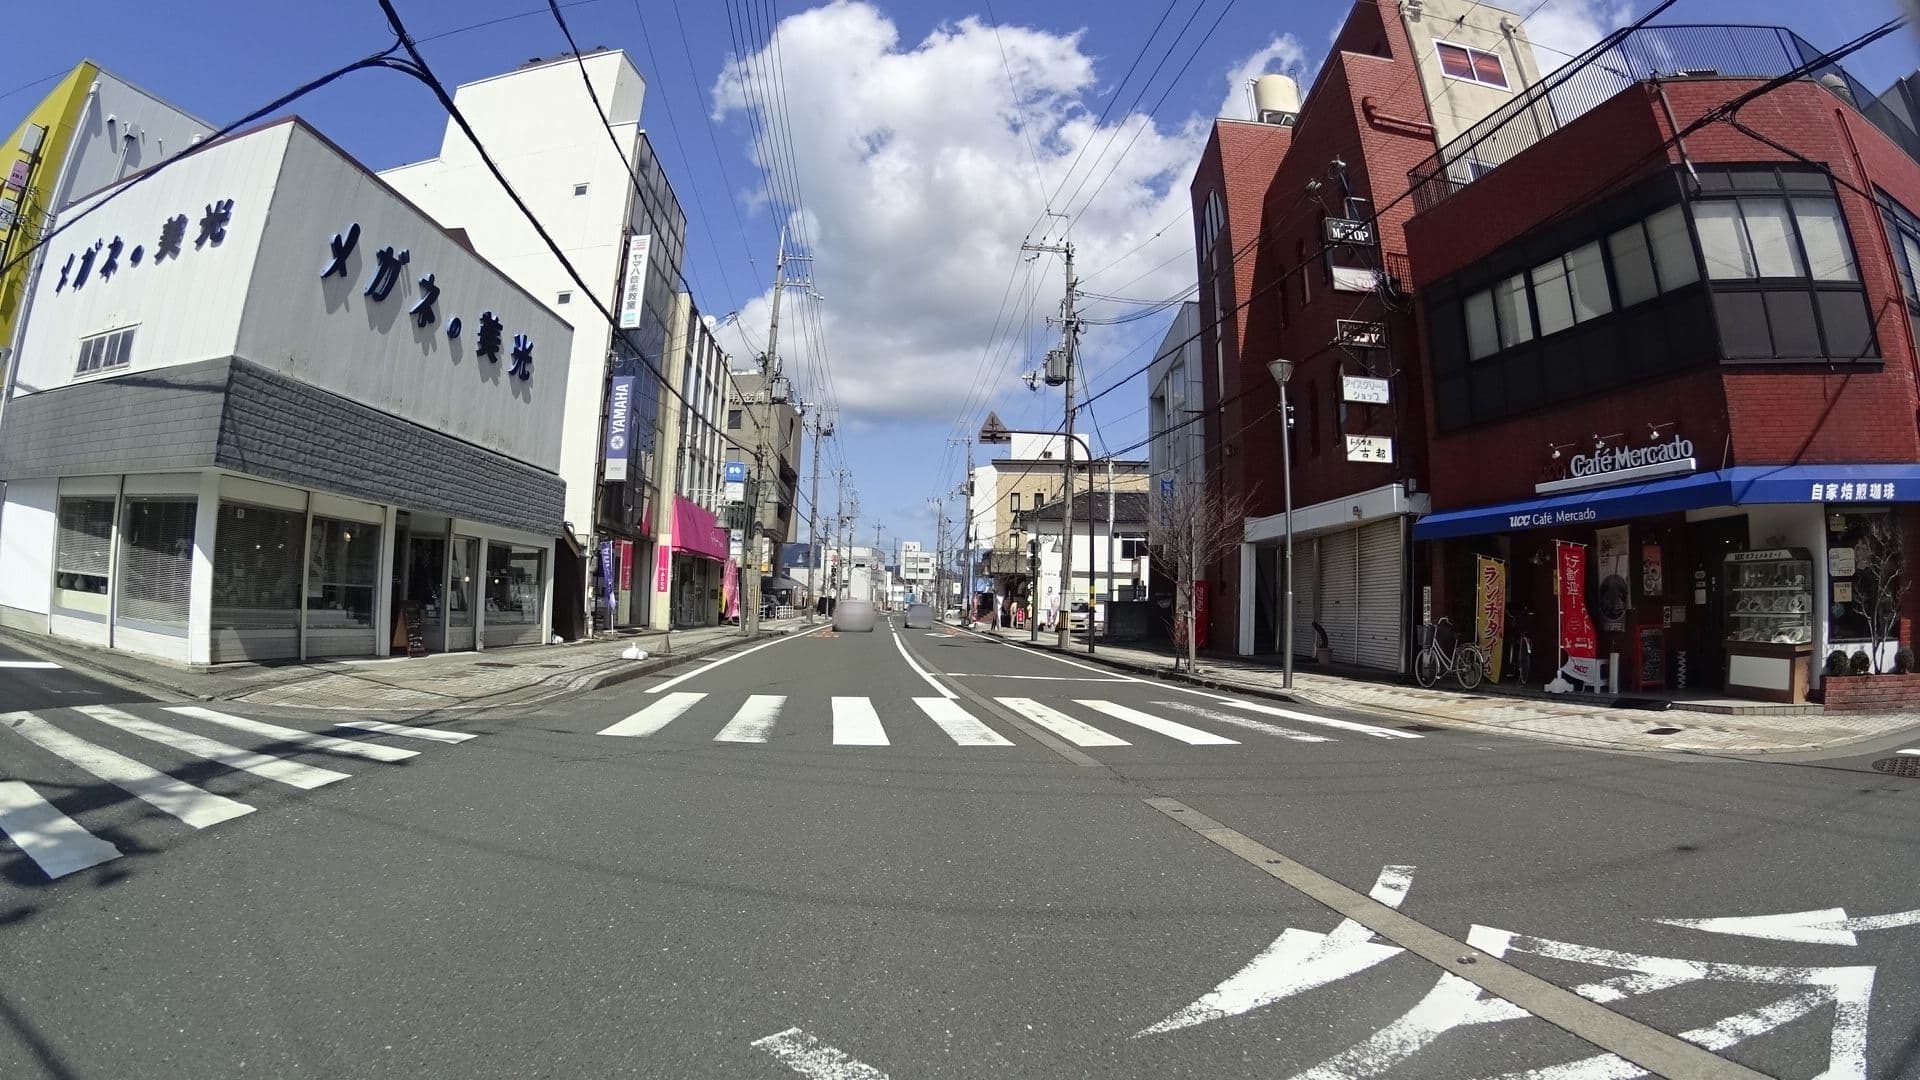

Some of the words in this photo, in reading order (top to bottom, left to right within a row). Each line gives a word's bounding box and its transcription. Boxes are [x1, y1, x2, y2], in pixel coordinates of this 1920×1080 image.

[55, 198, 234, 296] メガネの美光
[320, 222, 533, 381] メガネの美光
[626, 253, 643, 310] ヤマハ音楽教室
[611, 383, 629, 434] YAMAHA
[1571, 448, 1612, 477] Café
[1614, 434, 1693, 470] Mercado
[1509, 514, 1531, 527] UCC
[1533, 513, 1552, 526] Café
[1556, 507, 1596, 522] Mercado
[1811, 482, 1895, 501] 自家焙煎珈琲
[1483, 565, 1499, 676] ランチタイム
